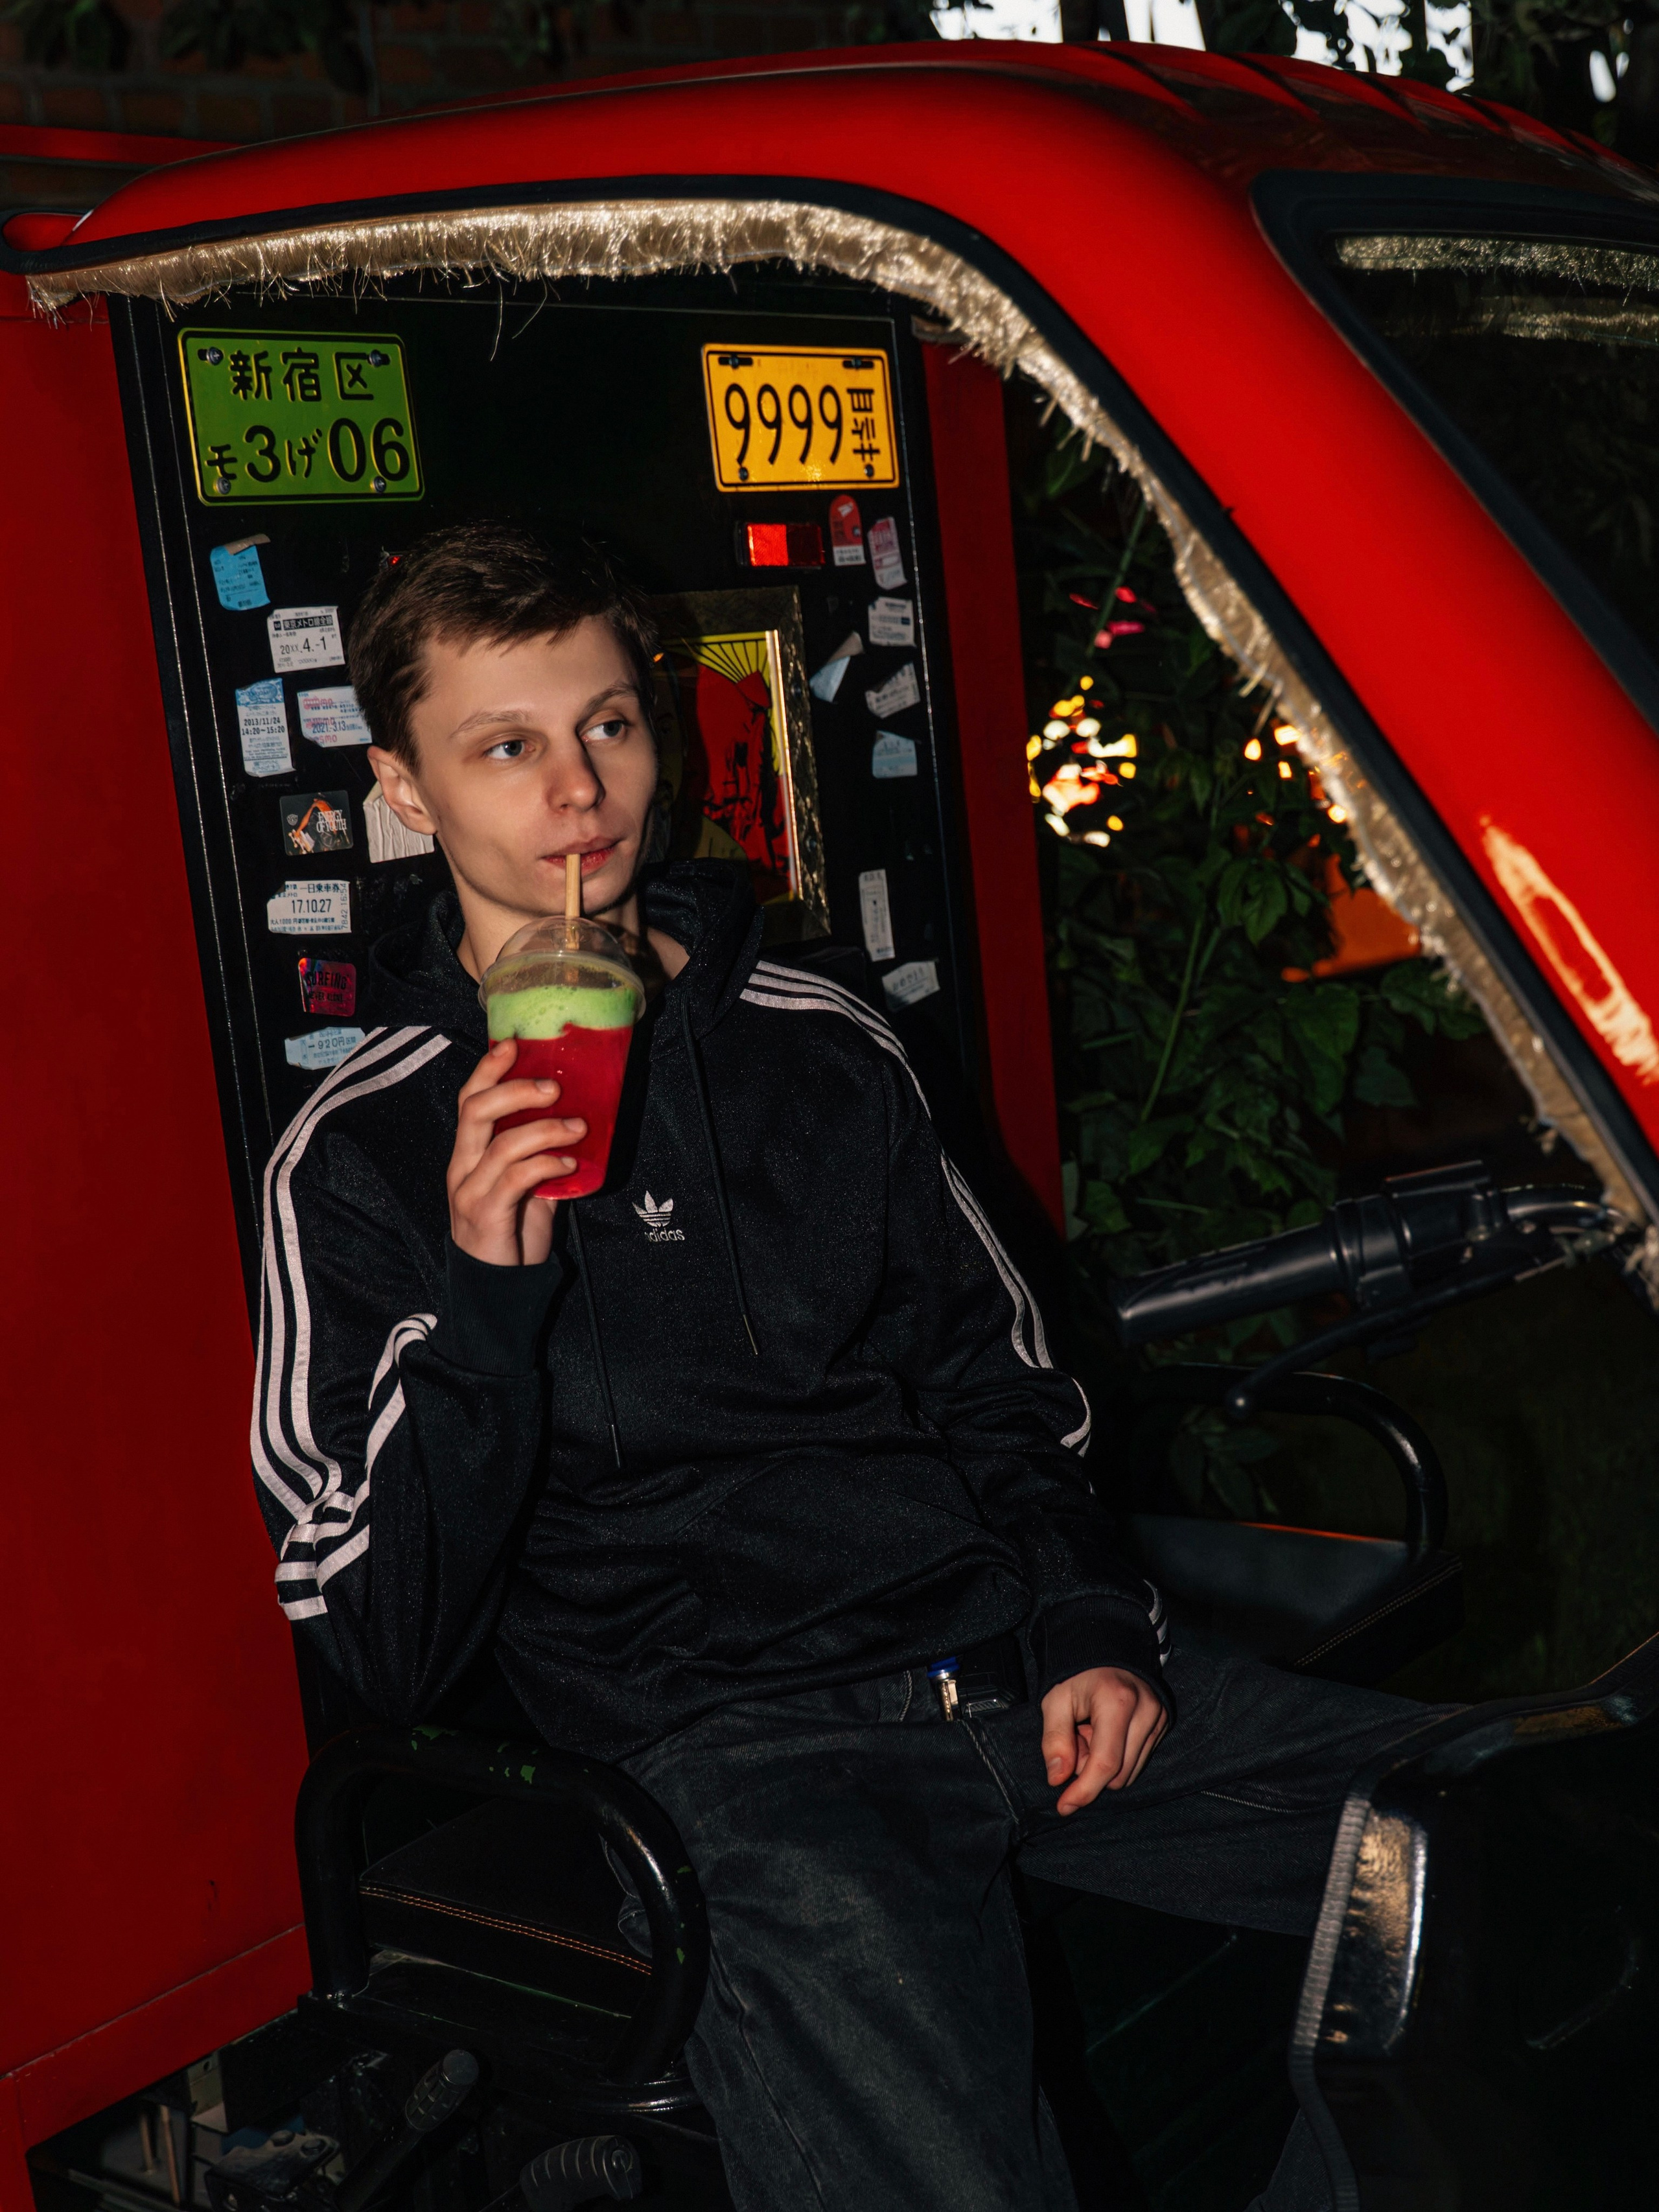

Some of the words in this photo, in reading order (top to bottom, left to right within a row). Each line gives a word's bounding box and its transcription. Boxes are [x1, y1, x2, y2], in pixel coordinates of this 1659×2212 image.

[229, 347, 375, 402] 新宿区
[244, 717, 281, 727] 2013/11/24
[300, 883, 340, 893] 一日乗車券
[292, 899, 332, 914] 17.10.27
[305, 971, 347, 990] SURFING
